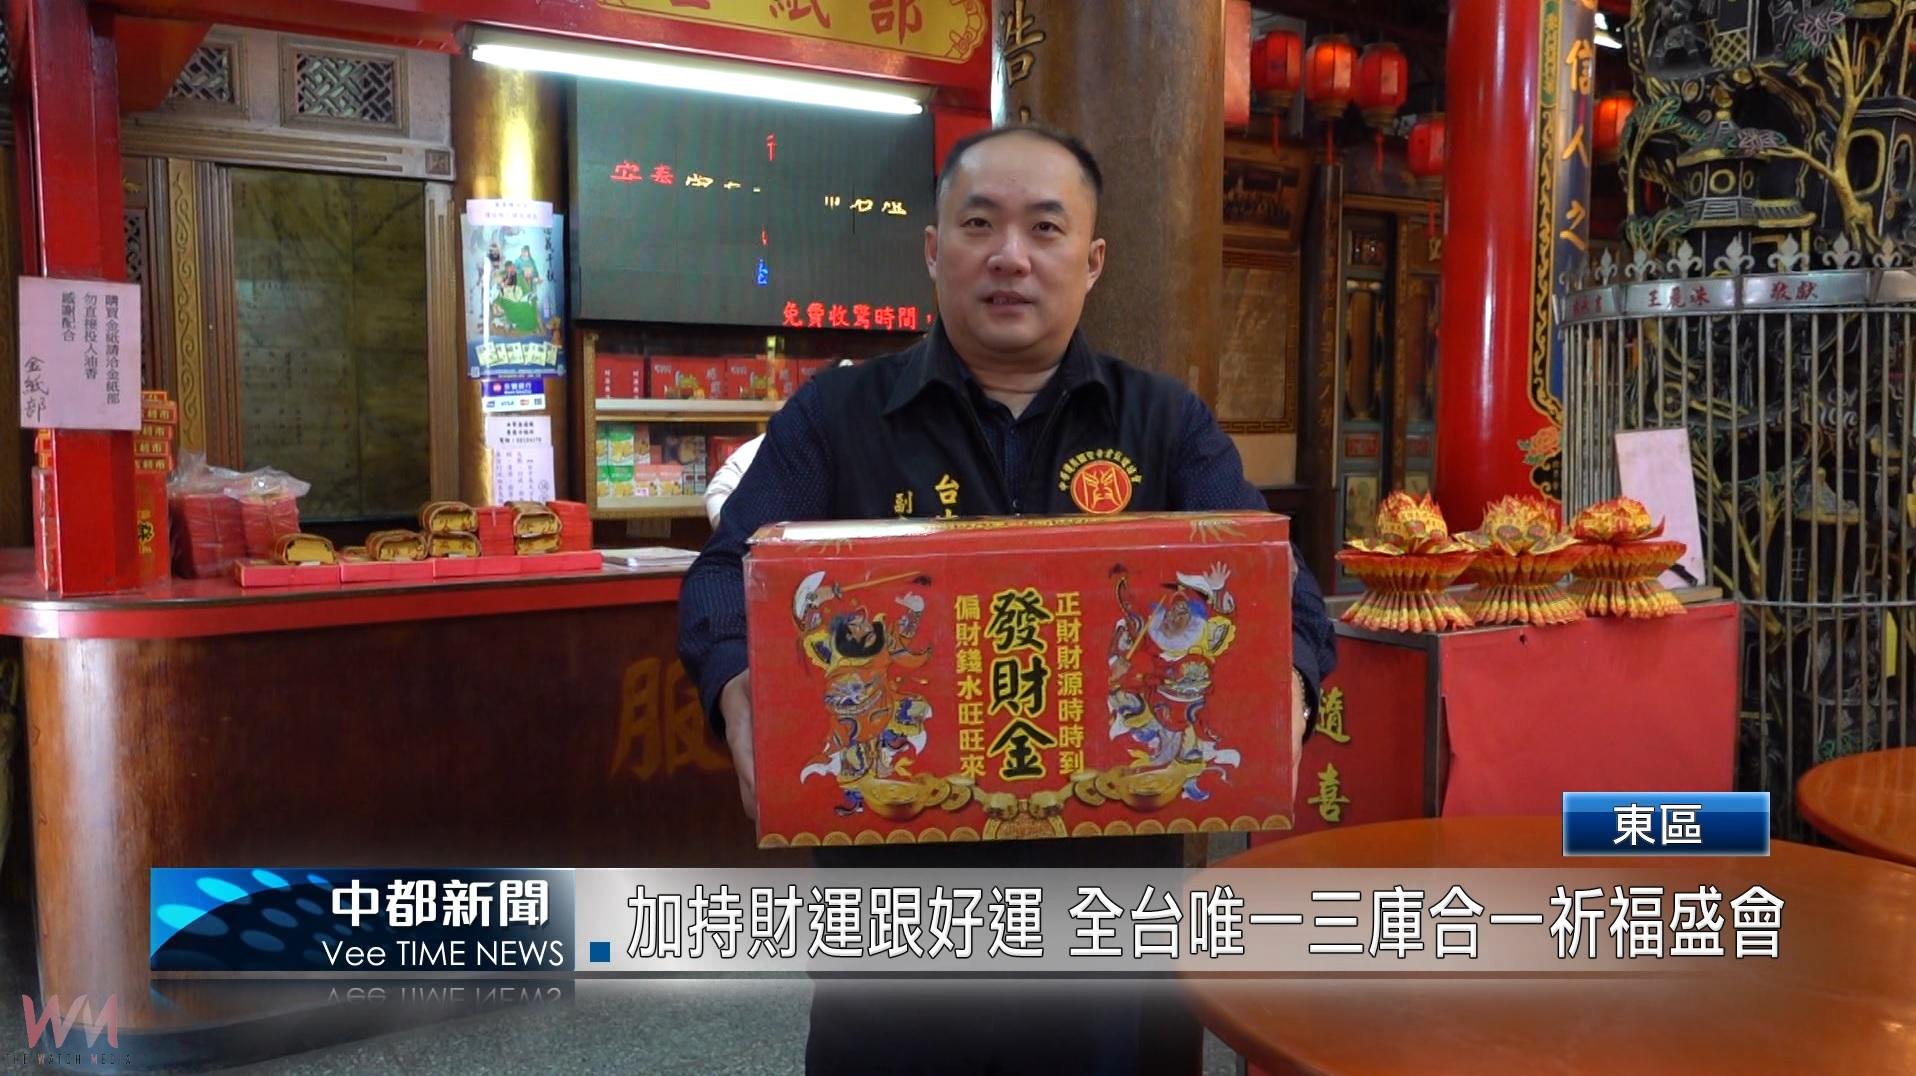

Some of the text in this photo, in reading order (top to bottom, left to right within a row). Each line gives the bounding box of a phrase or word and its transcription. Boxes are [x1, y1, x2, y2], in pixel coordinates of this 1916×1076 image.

[61, 291, 76, 342] 感謝配合
[23, 356, 49, 423] 金紙部
[935, 473, 960, 519] 台
[954, 594, 987, 778] 偏財錢水旺旺來
[984, 586, 1058, 782] 發財金
[1055, 591, 1085, 775] 正財財源時時到
